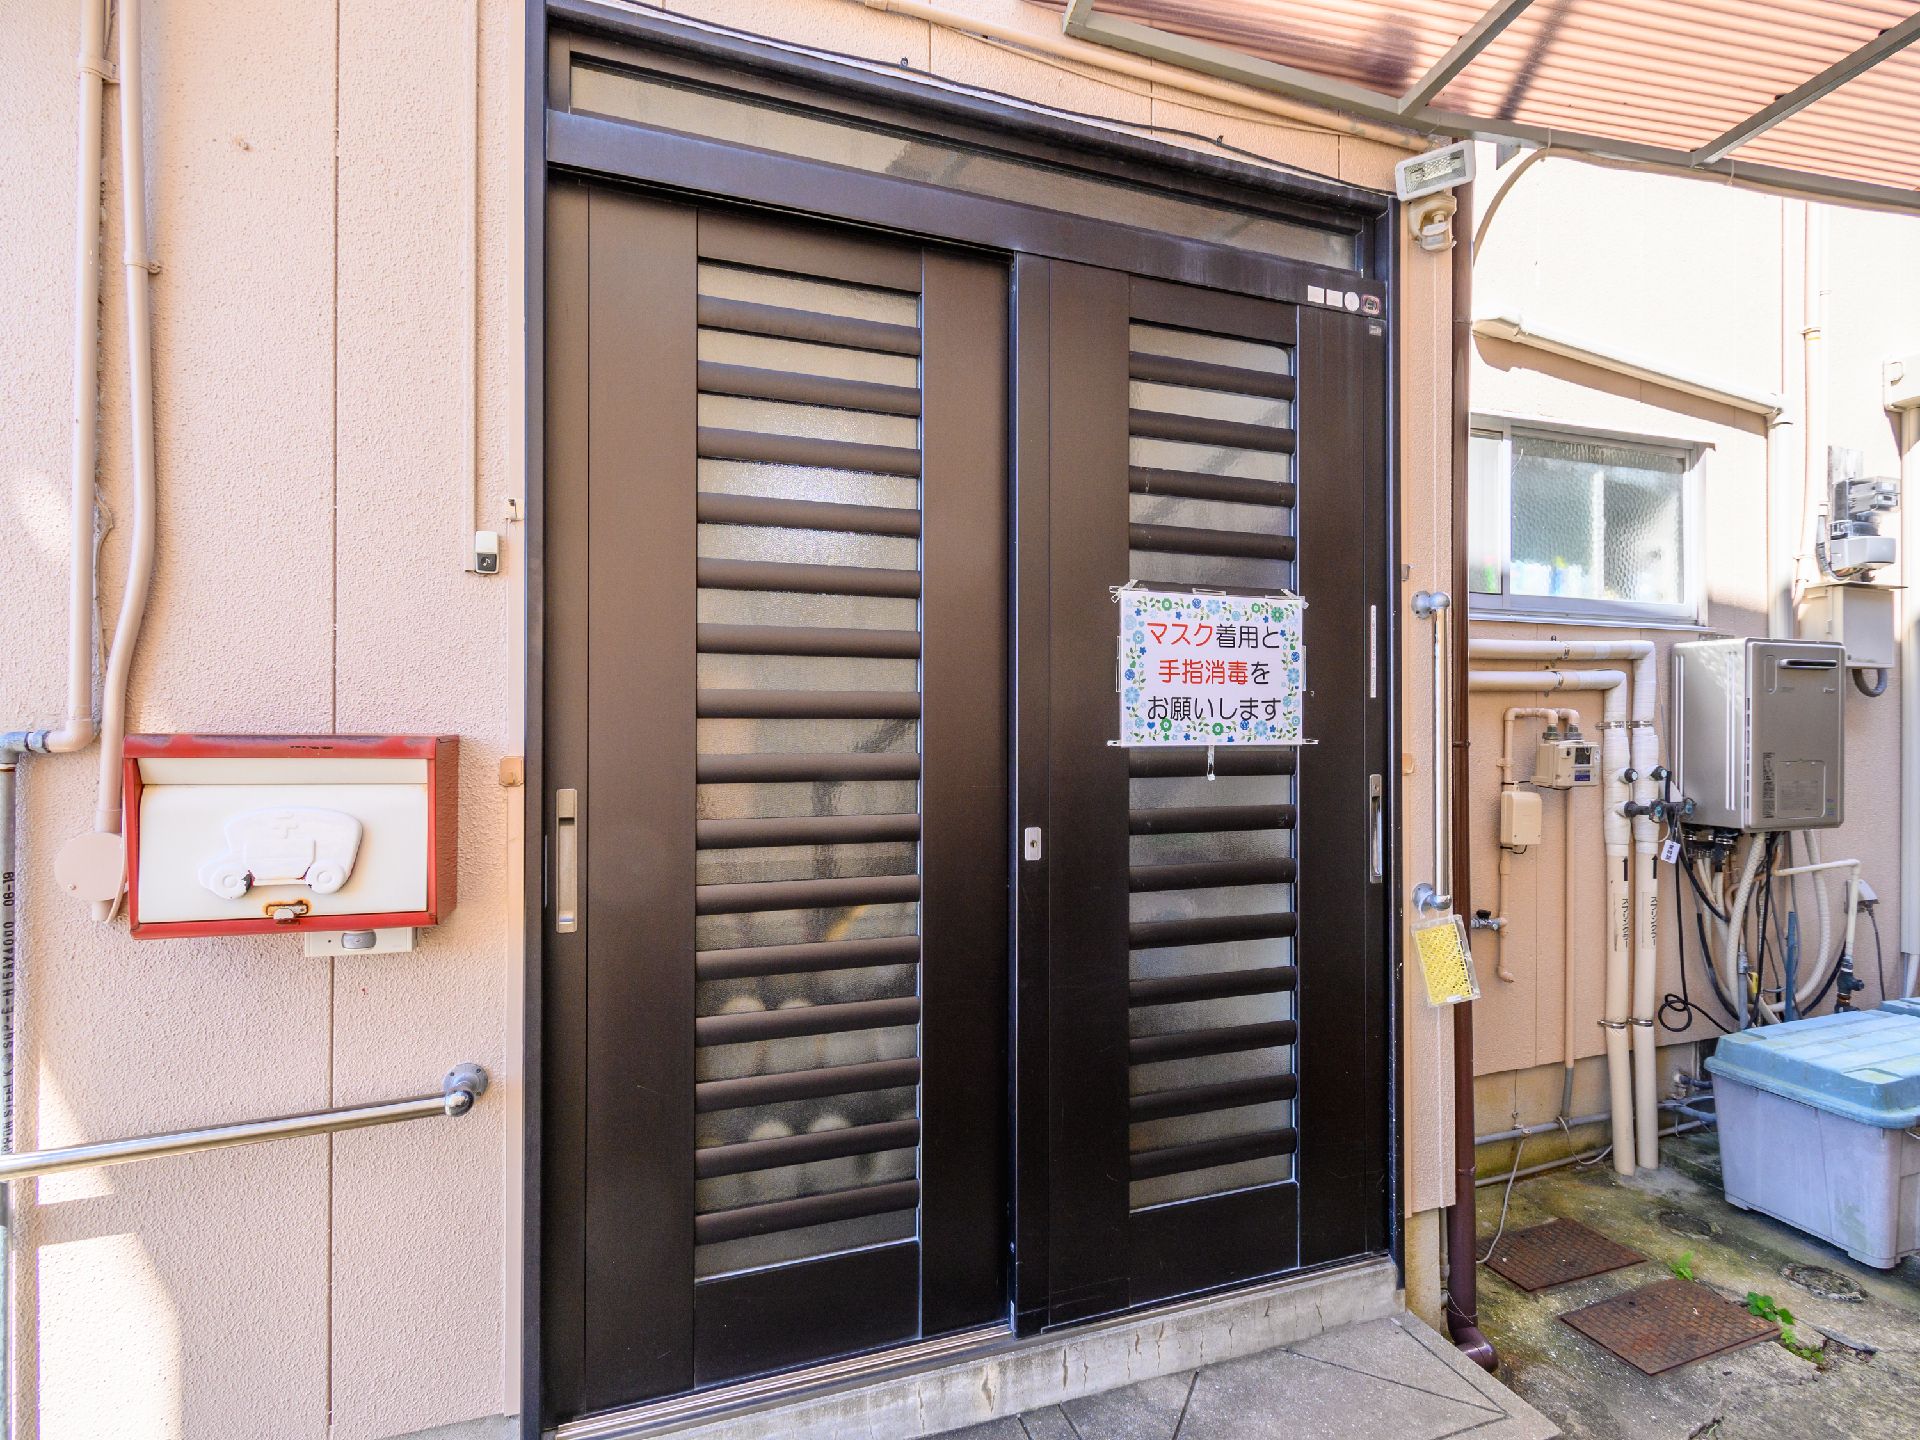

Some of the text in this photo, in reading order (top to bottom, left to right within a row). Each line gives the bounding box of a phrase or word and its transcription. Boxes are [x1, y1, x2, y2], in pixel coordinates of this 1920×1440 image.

[1147, 622, 1280, 649] マスク着用と
[1158, 658, 1270, 685] 手指消毒を
[1147, 695, 1281, 721] お願いします
